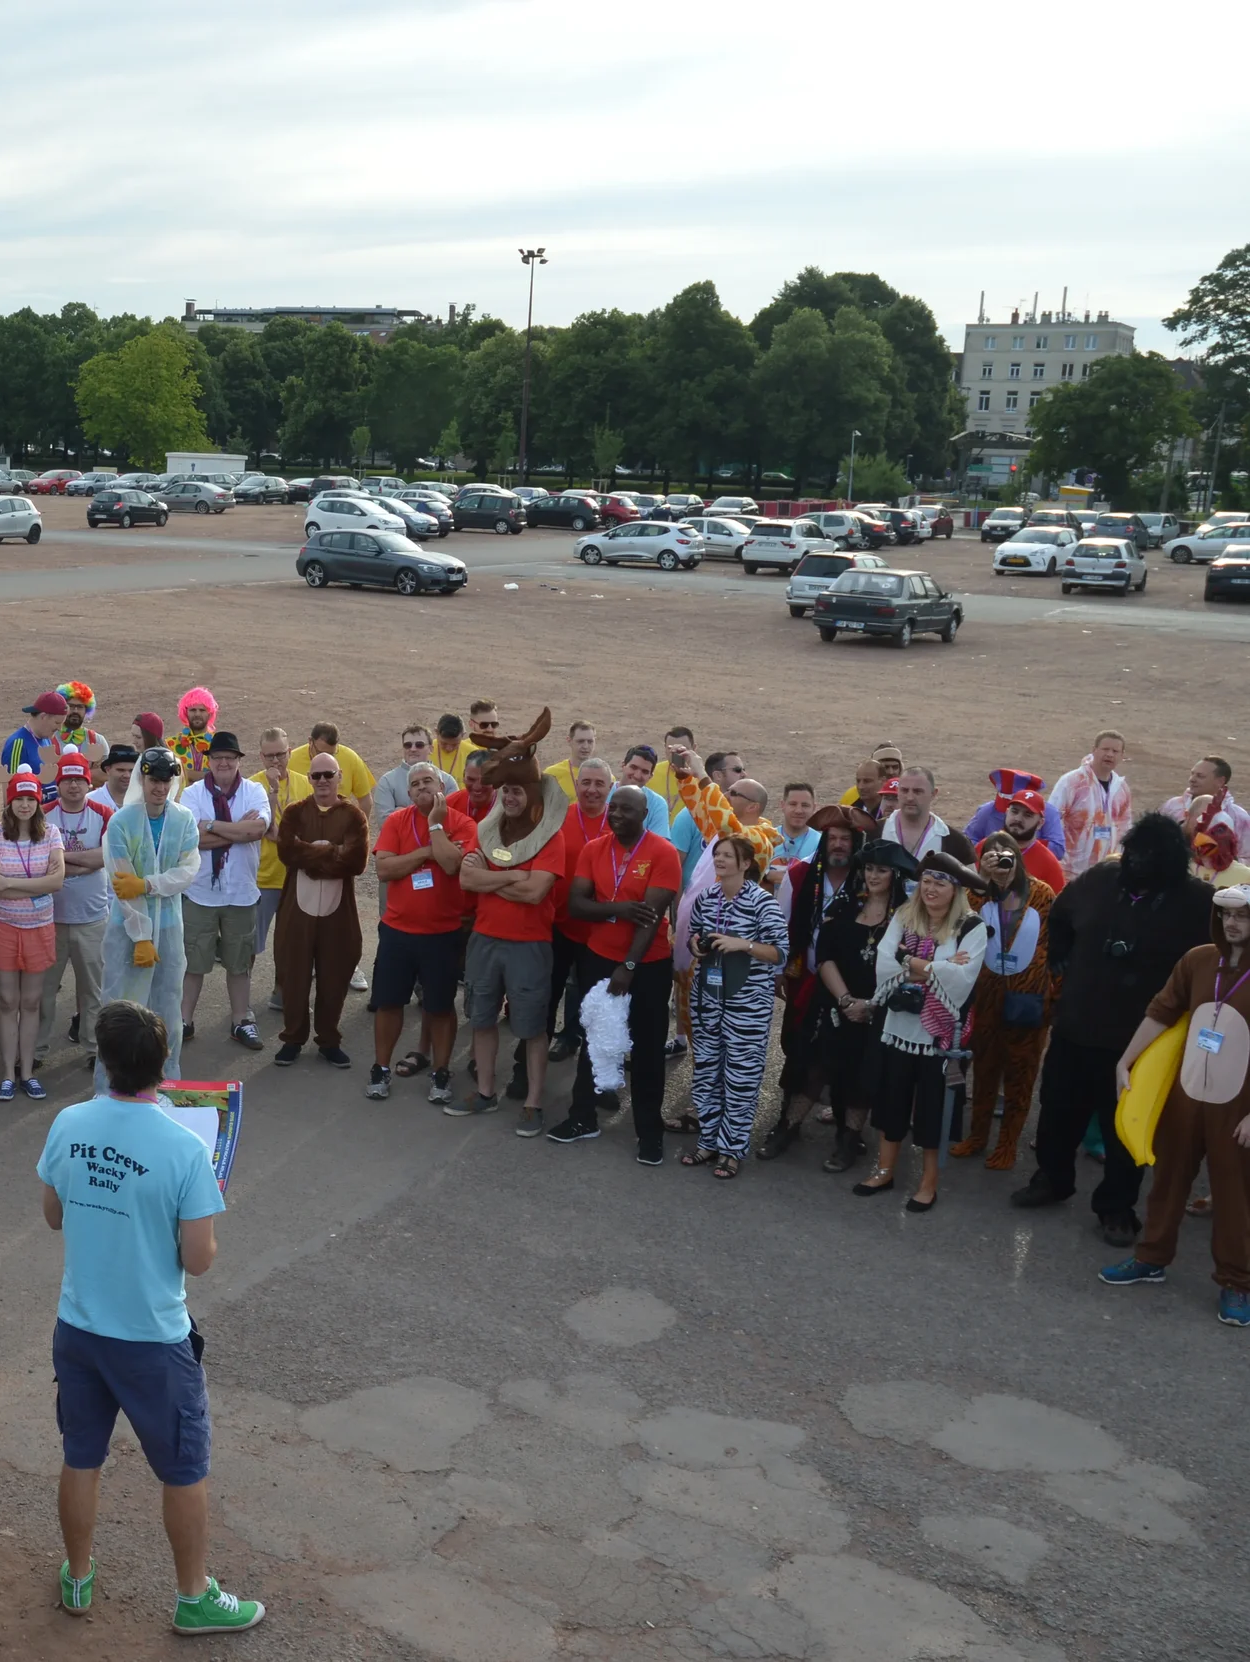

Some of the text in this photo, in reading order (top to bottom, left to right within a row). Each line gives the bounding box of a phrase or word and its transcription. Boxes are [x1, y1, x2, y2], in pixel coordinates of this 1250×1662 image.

[70, 1143, 150, 1177] Pit Crew
[86, 1161, 127, 1181] Wacky
[88, 1175, 121, 1194] Rally
